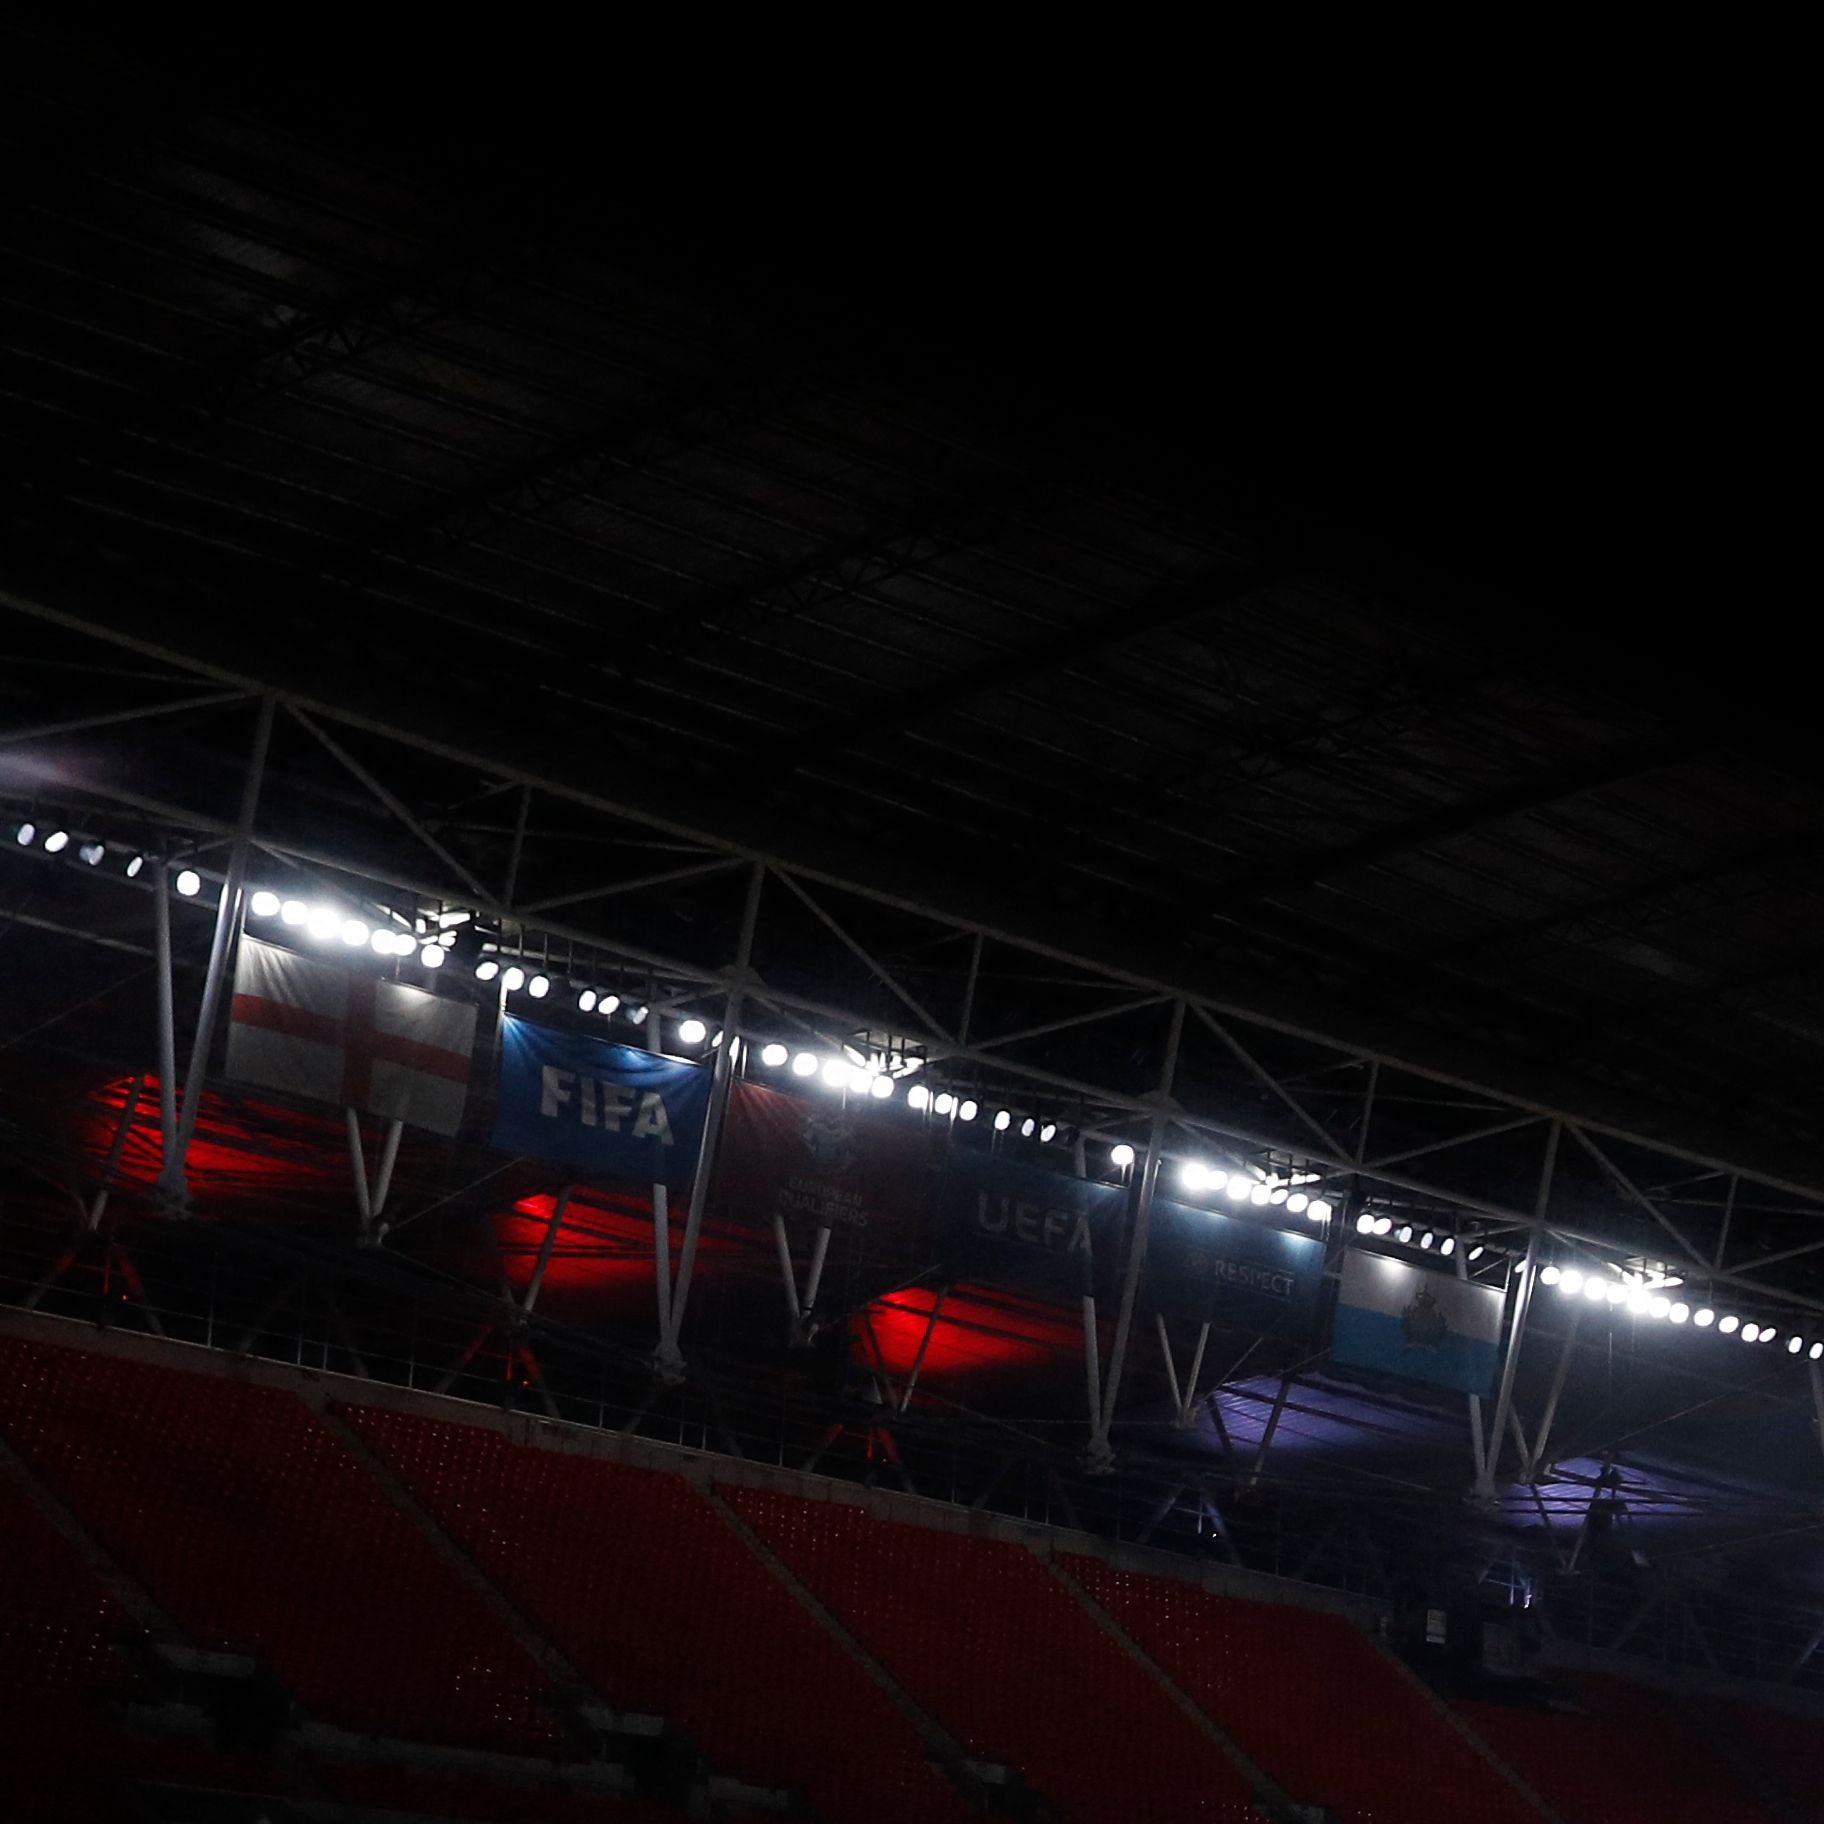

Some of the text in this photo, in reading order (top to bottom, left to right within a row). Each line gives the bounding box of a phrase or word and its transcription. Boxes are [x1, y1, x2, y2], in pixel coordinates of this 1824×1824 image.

[541, 1064, 674, 1146] FIFA
[979, 1188, 1093, 1257] UEFA
[1215, 1260, 1294, 1296] RESPECT
